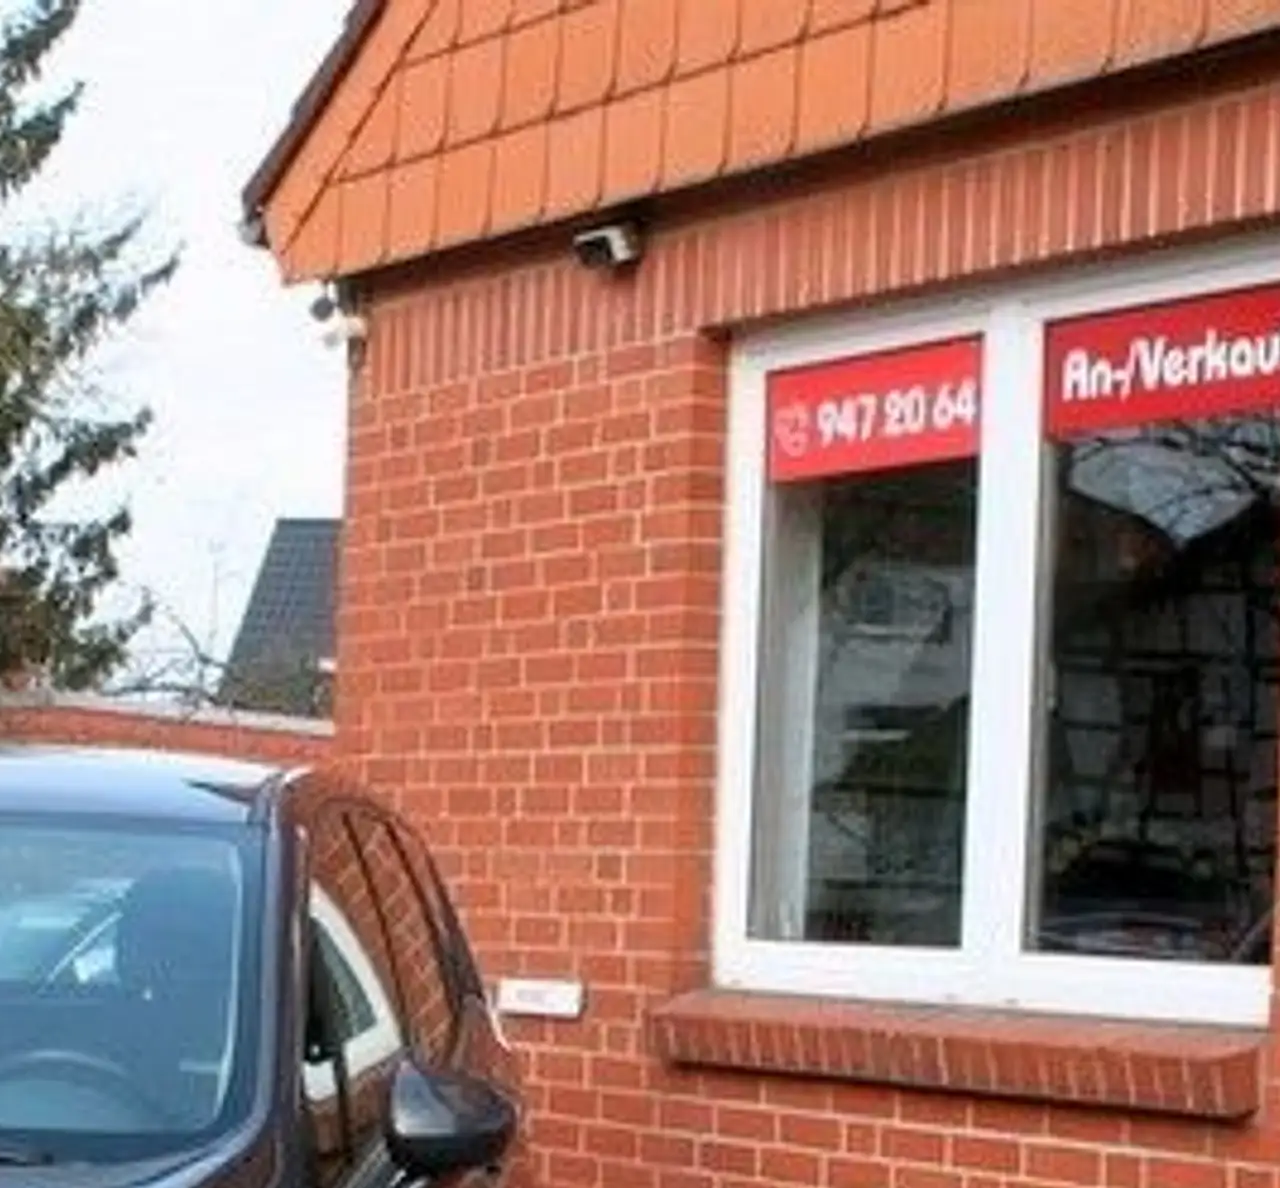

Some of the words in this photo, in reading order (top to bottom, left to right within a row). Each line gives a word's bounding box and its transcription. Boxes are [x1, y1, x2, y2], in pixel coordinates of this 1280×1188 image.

[817, 394, 876, 447] 947
[884, 383, 926, 438] 20
[932, 376, 978, 432] 64
